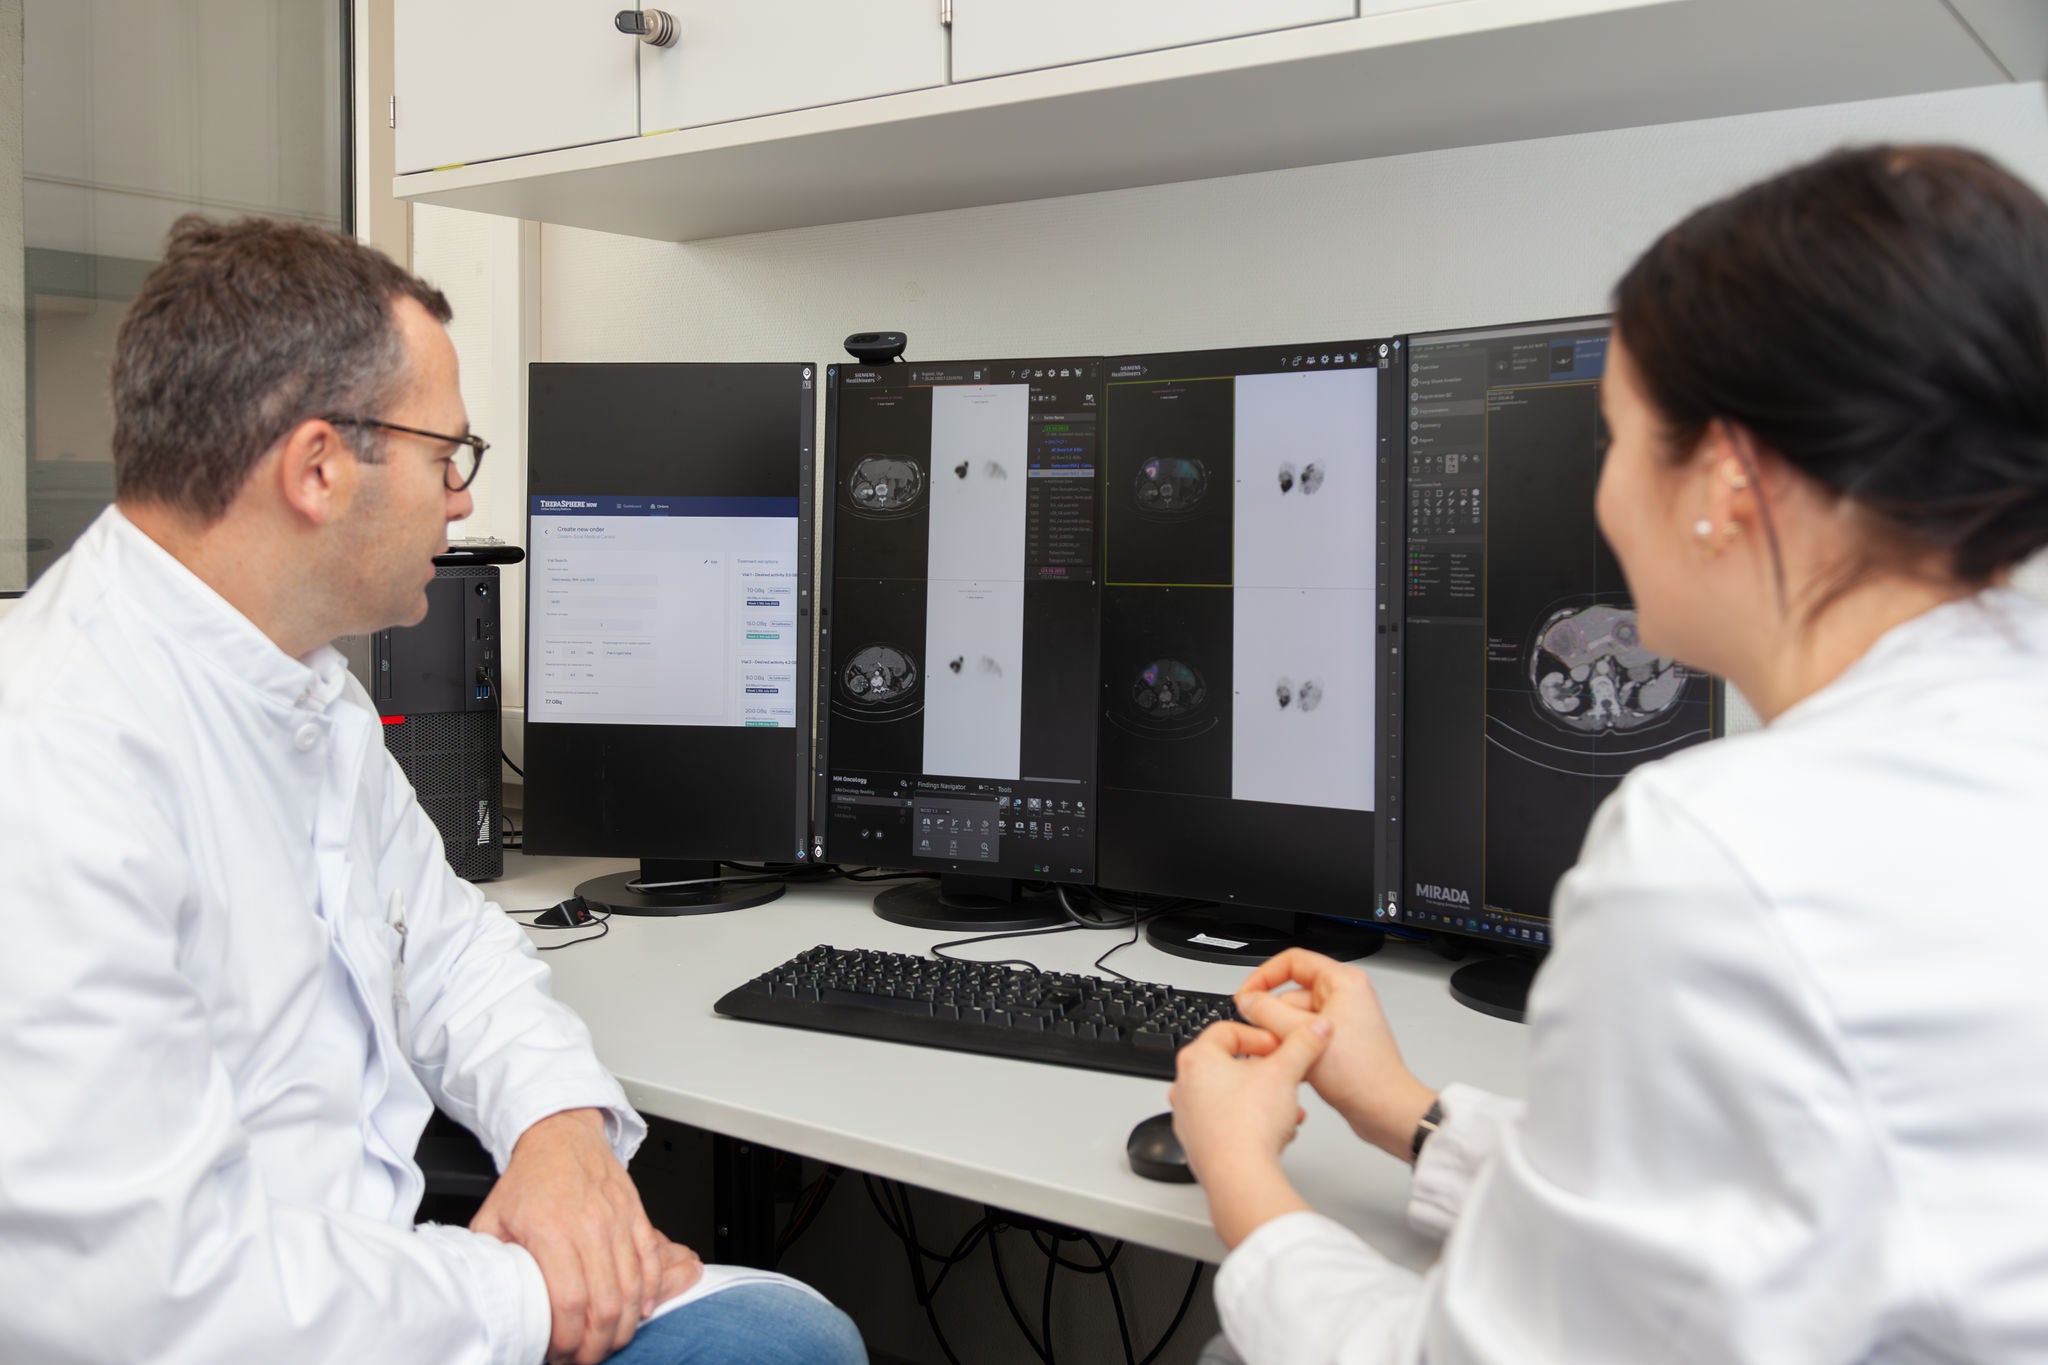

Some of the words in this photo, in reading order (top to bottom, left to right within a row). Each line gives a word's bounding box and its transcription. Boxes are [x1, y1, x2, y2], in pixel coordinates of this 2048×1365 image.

[843, 776, 868, 785] Oncology
[917, 781, 940, 790] Findings
[940, 782, 966, 792] Navigator
[1416, 883, 1470, 904] MIRADA
